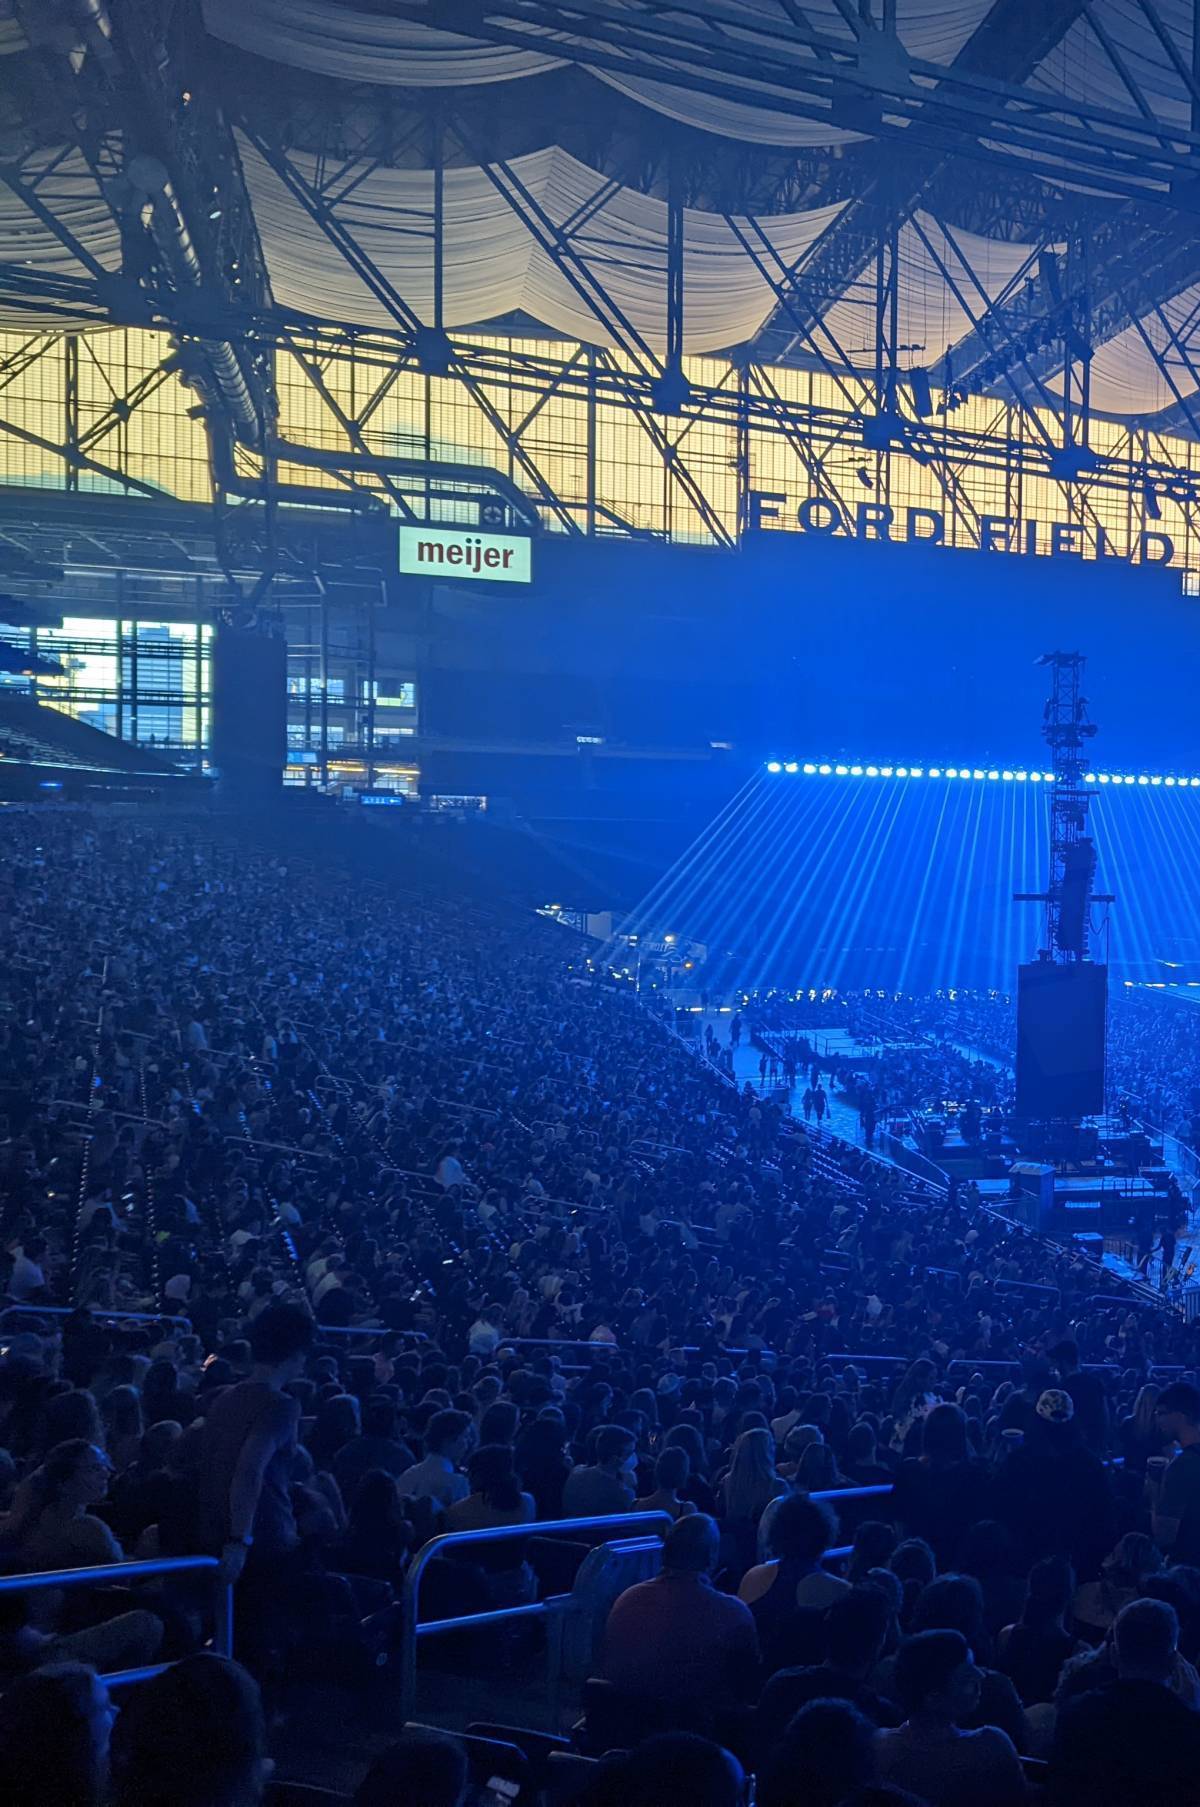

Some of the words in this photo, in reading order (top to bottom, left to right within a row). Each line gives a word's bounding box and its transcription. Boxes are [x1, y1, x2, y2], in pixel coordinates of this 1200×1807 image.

[417, 537, 514, 573] meijer
[748, 490, 945, 543] FORD
[980, 514, 1175, 567] FIELD
